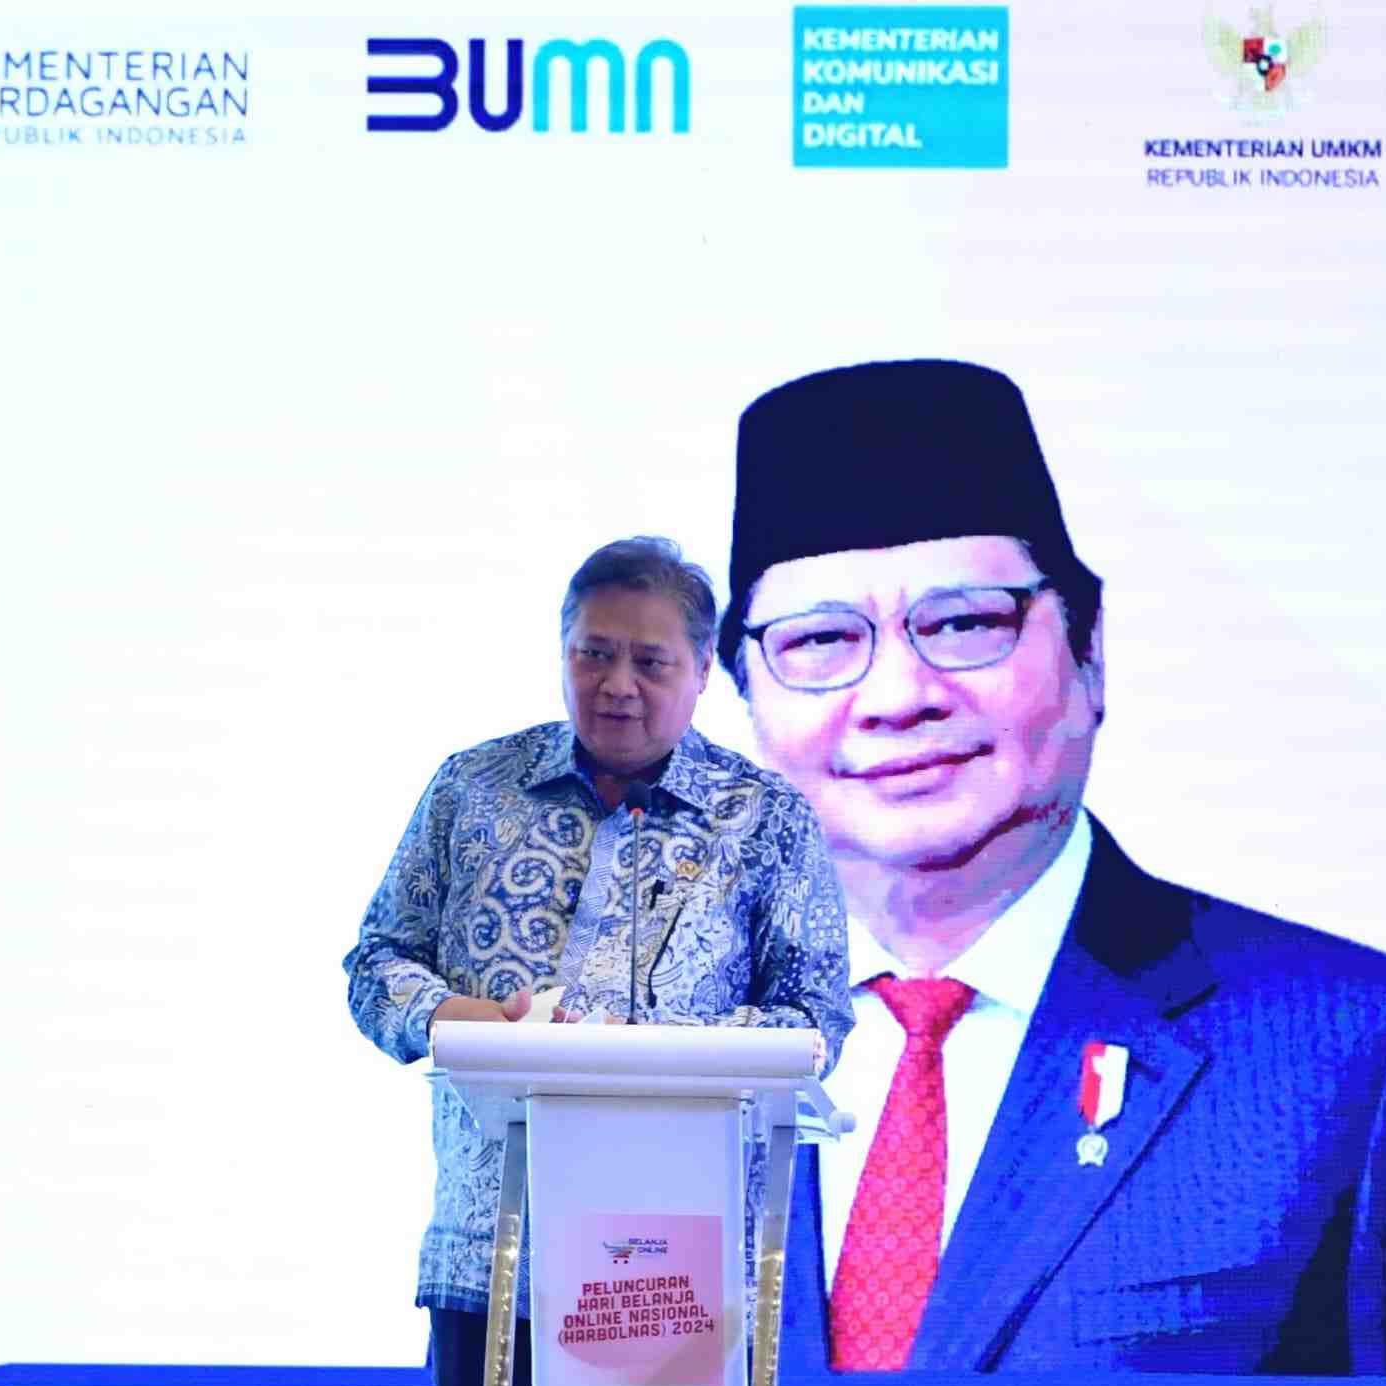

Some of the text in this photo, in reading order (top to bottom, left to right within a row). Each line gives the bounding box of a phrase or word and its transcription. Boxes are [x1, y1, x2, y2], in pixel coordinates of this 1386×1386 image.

[803, 28, 998, 51] KEMENTERIAN
[803, 60, 998, 84] KOMUNIKASI
[803, 91, 865, 115] DAN
[97, 126, 247, 145] INDONESIA
[803, 123, 923, 147] DIGITAL
[1144, 139, 1383, 158] KEMENTERIAN UMKM
[1146, 169, 1380, 188] REPUBLIK INDONESIA
[582, 1275, 690, 1297] PELUNCURAN
[577, 1290, 695, 1313] HARI BELANJA
[564, 1305, 709, 1329] ONLINE NASIONAL
[558, 1319, 715, 1346] (HARBOLNAS) 2024
